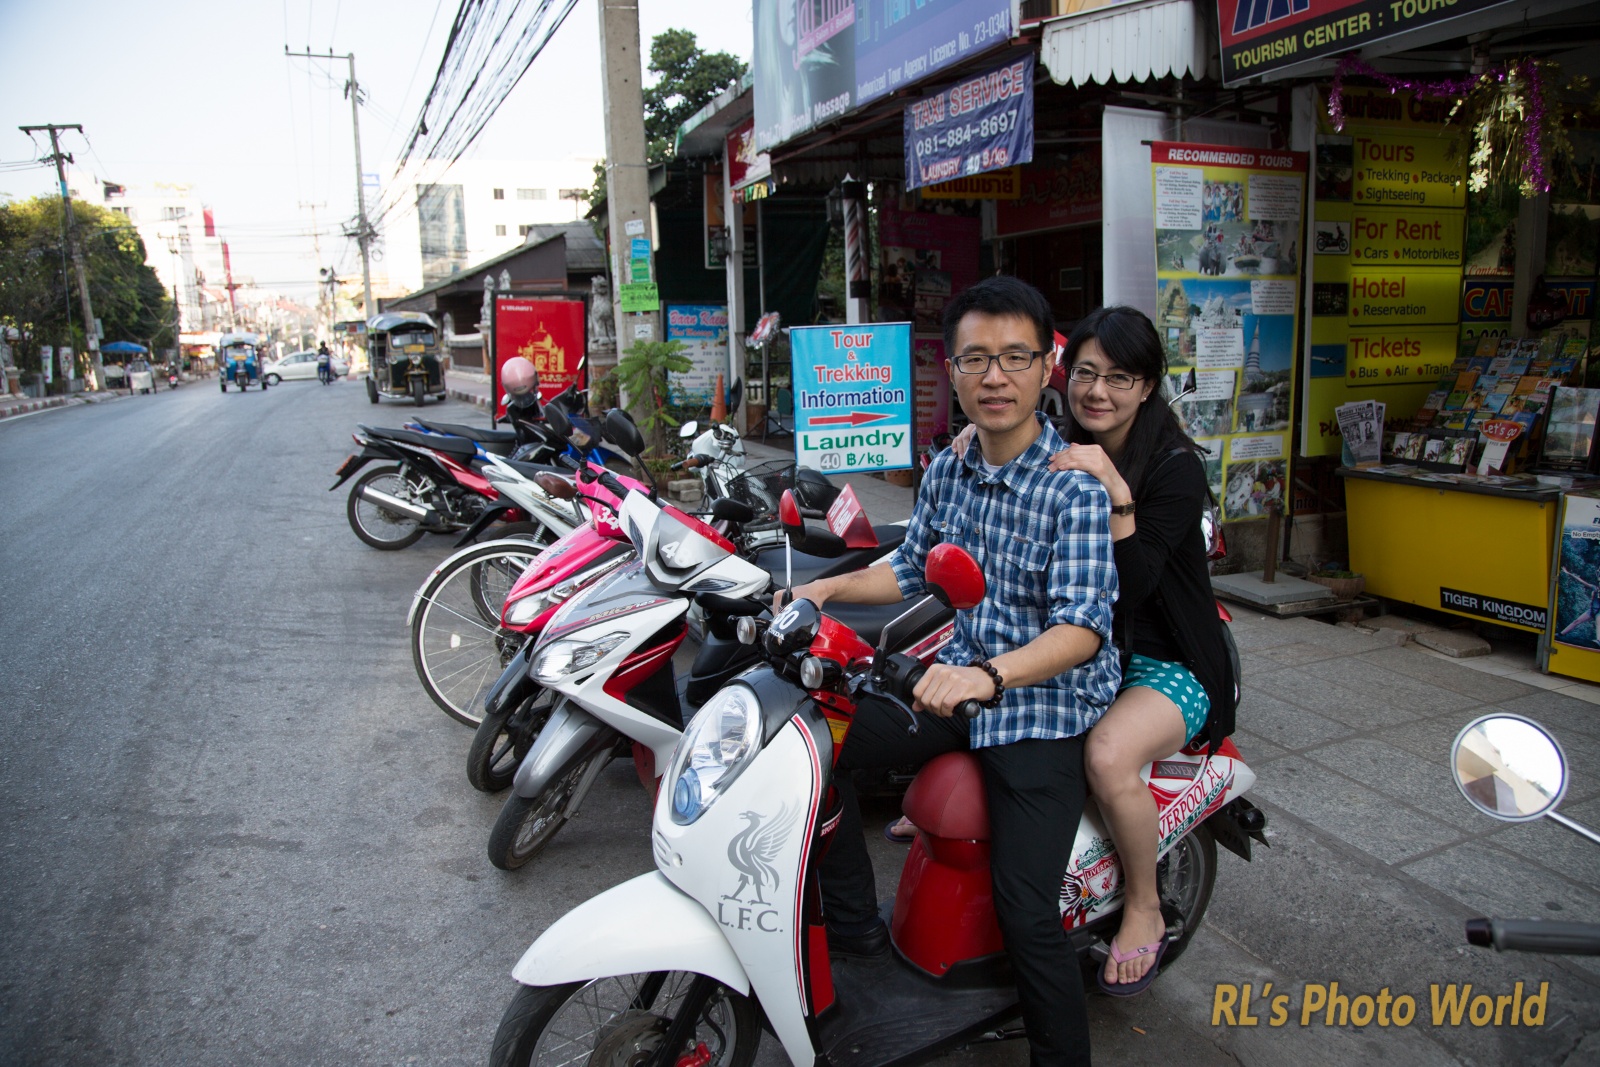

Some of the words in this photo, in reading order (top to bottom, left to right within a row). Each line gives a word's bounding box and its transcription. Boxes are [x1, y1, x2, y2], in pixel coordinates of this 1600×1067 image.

[1232, 35, 1298, 71] TOURISM
[1303, 12, 1371, 49] CENTER
[857, 72, 886, 99] Authorized
[888, 64, 902, 84] Tour
[904, 54, 927, 79] Agency
[929, 41, 956, 67] Licence
[958, 31, 971, 52] No.
[974, 8, 1009, 44] 23-0341
[912, 94, 945, 130] TAXI
[950, 61, 1025, 117] SERVICE
[814, 91, 850, 122] Massage
[915, 109, 1018, 157] 081-884-8697
[1168, 148, 1255, 166] RECOMMENDED
[1259, 156, 1293, 168] TOURS
[1356, 138, 1415, 162] Tours
[921, 156, 962, 183] LAUNDRY
[965, 153, 981, 175] 40
[1366, 168, 1410, 184] Trekking
[1366, 187, 1426, 203] Sightseeing
[1354, 217, 1388, 240] For
[1396, 219, 1442, 241] Rent
[1363, 247, 1389, 259] Cars
[1402, 249, 1460, 260] Motorbikes
[1352, 277, 1406, 299] Hotel
[669, 310, 697, 326] Baan
[1363, 304, 1426, 316] Reservation
[831, 331, 873, 348] Tour
[1350, 337, 1421, 359] Tickets
[847, 351, 856, 360] &
[814, 364, 891, 383] Trekking
[1358, 367, 1378, 378] Bus
[1393, 365, 1409, 376] Air
[1423, 363, 1449, 375] Train
[802, 387, 904, 408] Information
[803, 430, 905, 450] Laundry
[1483, 421, 1505, 436] Let's
[1505, 428, 1518, 439] go
[820, 454, 841, 469] 40
[597, 507, 619, 530] 34
[1442, 591, 1478, 609] TIGER
[1482, 600, 1546, 623] KINGDOM
[1161, 764, 1191, 777] NEVER
[1159, 780, 1208, 840] VERPOOL
[1170, 820, 1190, 842] ARE
[1190, 801, 1207, 820] THE
[1208, 782, 1224, 801] KOP
[717, 901, 784, 933] L.F.C.
